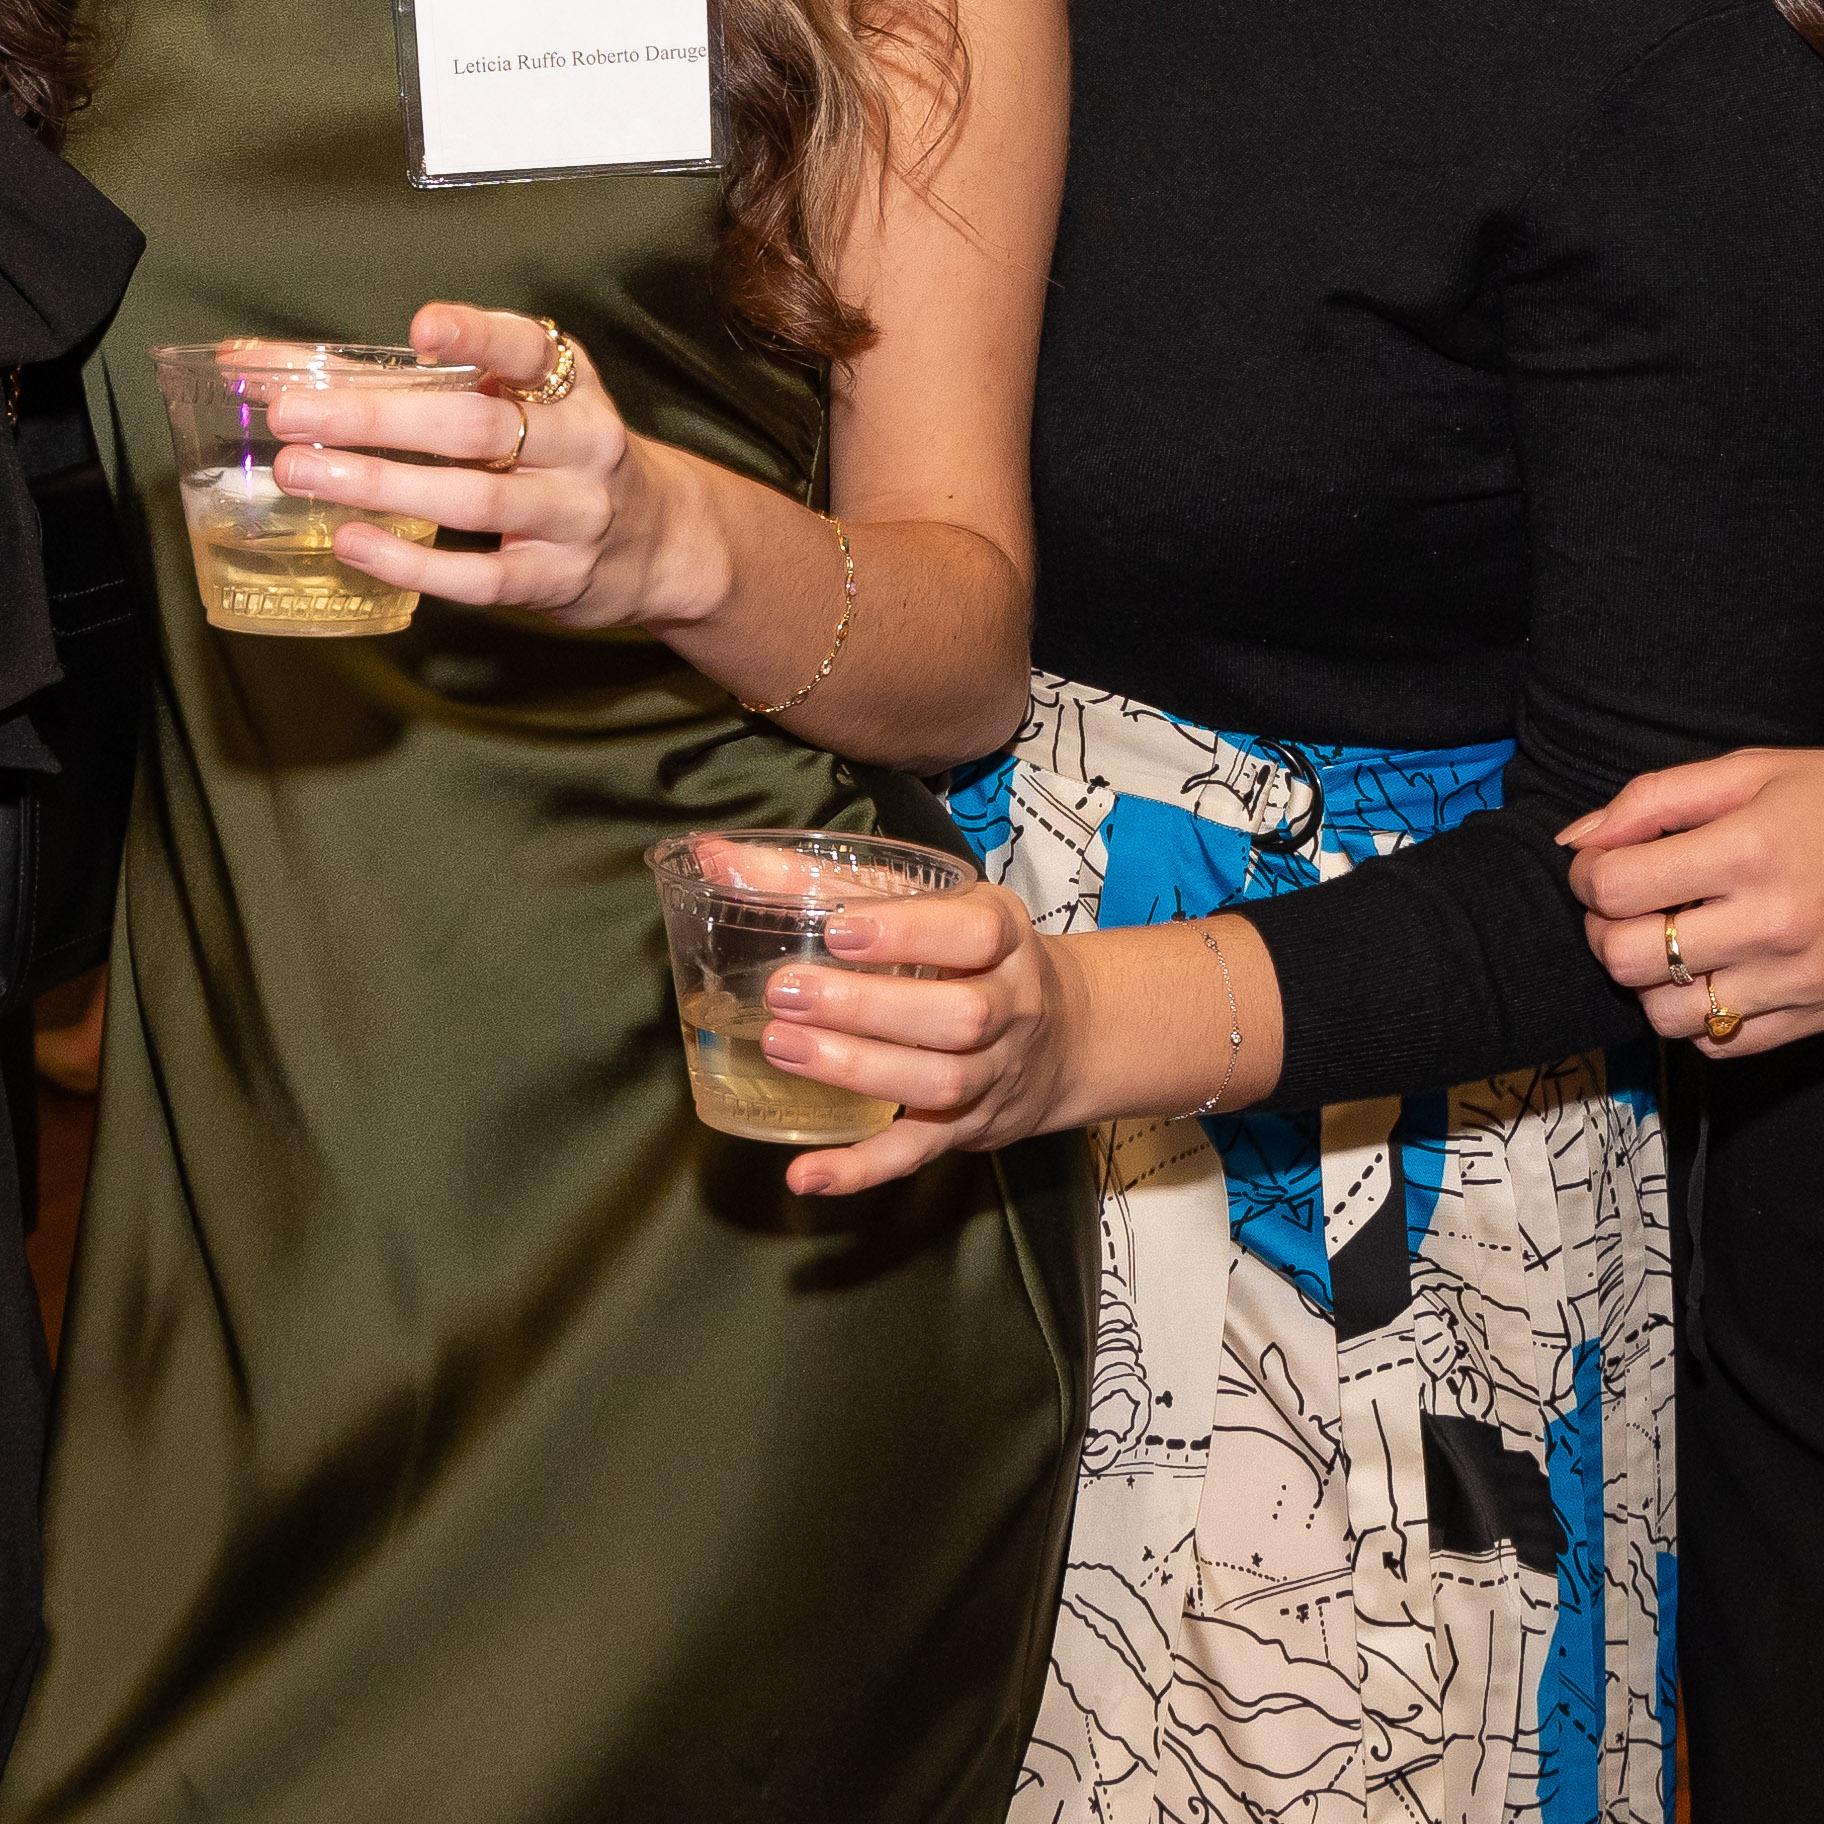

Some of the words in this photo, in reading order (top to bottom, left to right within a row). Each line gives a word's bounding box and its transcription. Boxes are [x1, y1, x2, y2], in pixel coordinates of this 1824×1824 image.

[453, 55, 512, 75] Leticia
[517, 52, 566, 71] Ruffo
[572, 49, 640, 67] Roberto
[645, 44, 707, 63] Daruge
